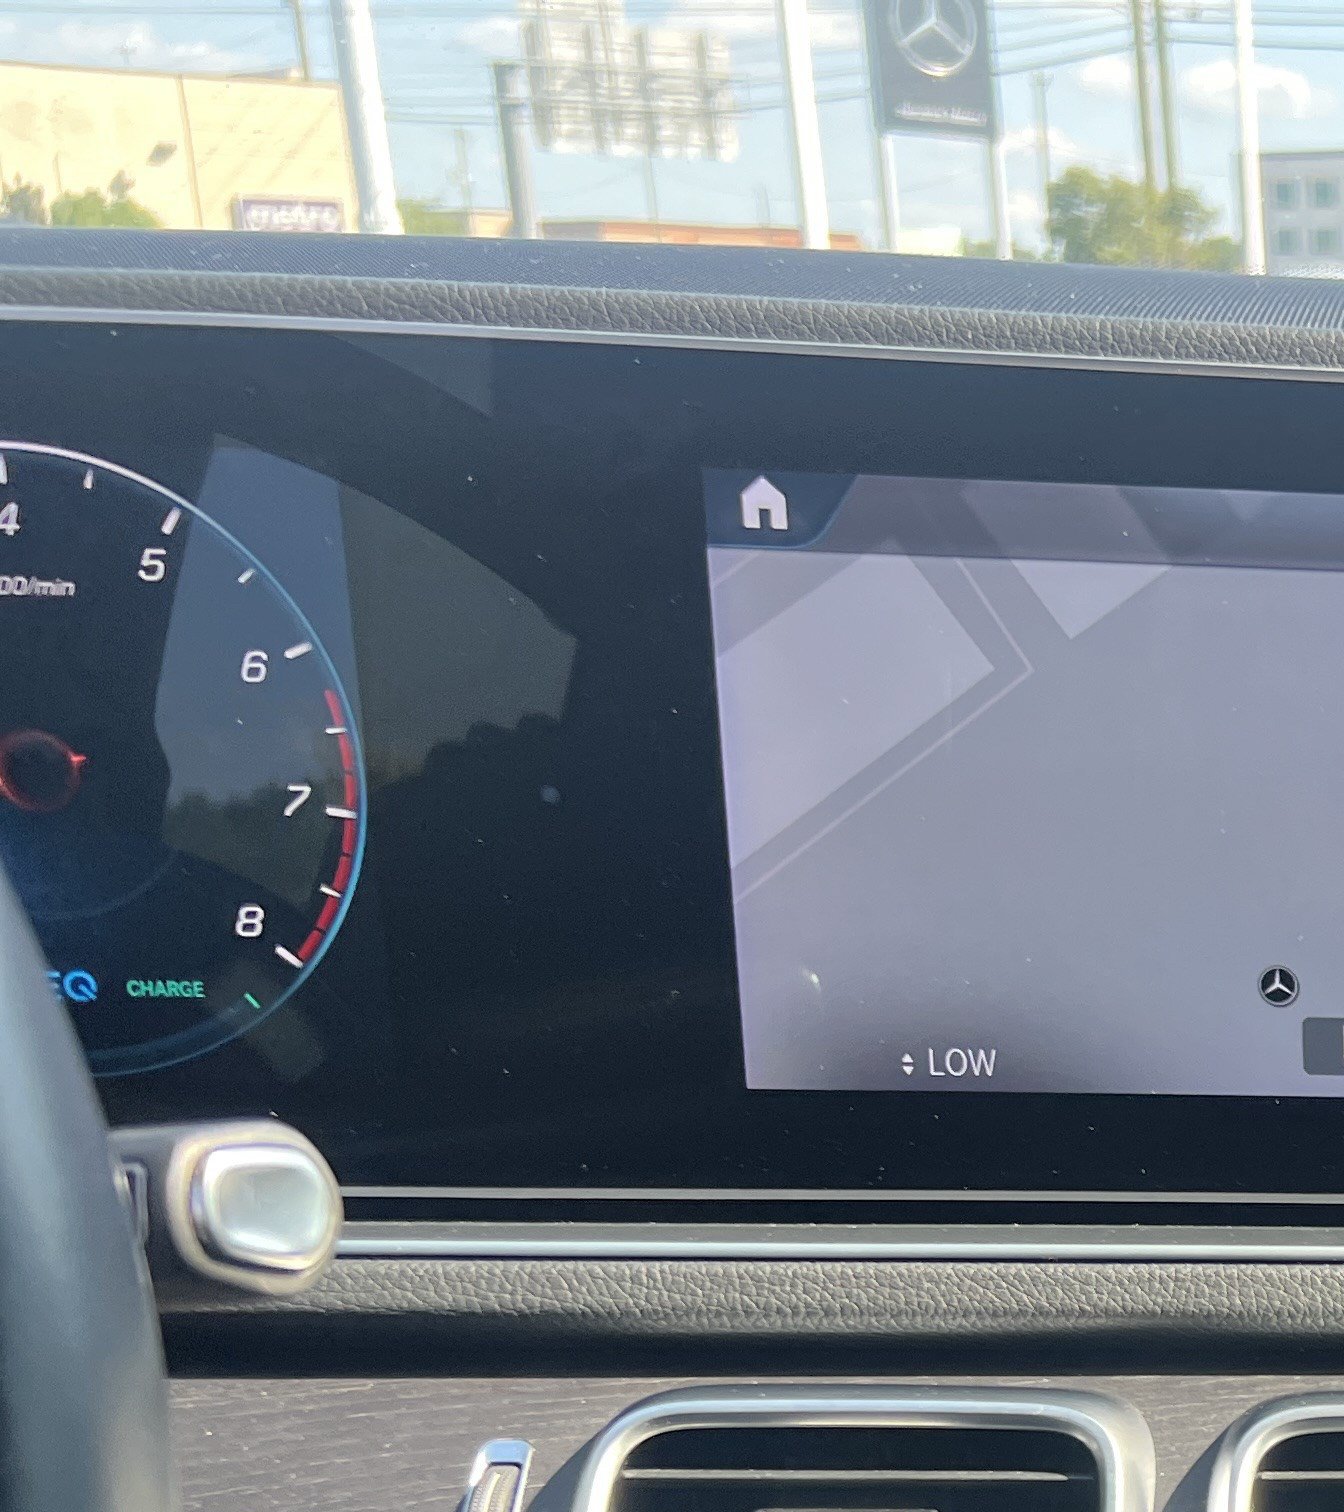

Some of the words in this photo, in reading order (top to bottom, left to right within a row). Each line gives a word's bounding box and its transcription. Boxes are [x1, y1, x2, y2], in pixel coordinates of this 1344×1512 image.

[0, 501, 21, 536] 4
[137, 547, 167, 582] 5
[240, 650, 270, 683] 6
[282, 784, 312, 817] 7
[234, 903, 265, 937] 8
[126, 979, 206, 998] CHARGE
[928, 1047, 997, 1077] LOW
